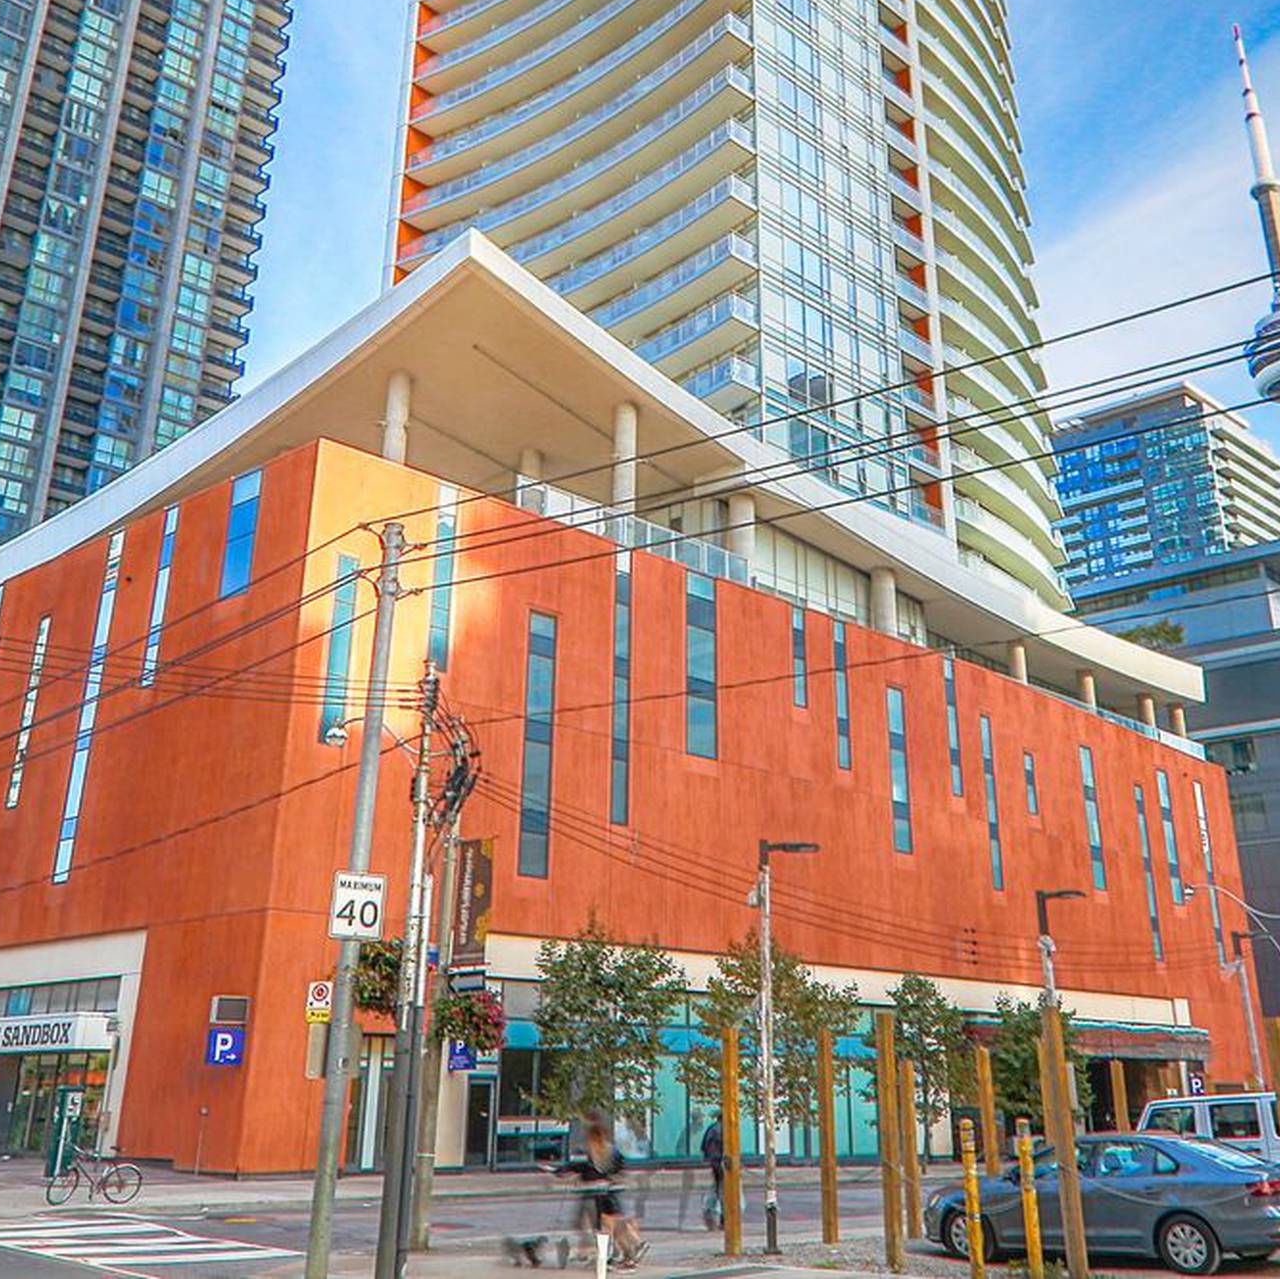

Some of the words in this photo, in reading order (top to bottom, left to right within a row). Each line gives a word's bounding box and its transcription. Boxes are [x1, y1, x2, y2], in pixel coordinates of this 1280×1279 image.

[336, 899, 378, 928] 40
[1, 1022, 73, 1047] SANDBOX
[213, 1032, 233, 1061] P
[1191, 1078, 1202, 1094] P
